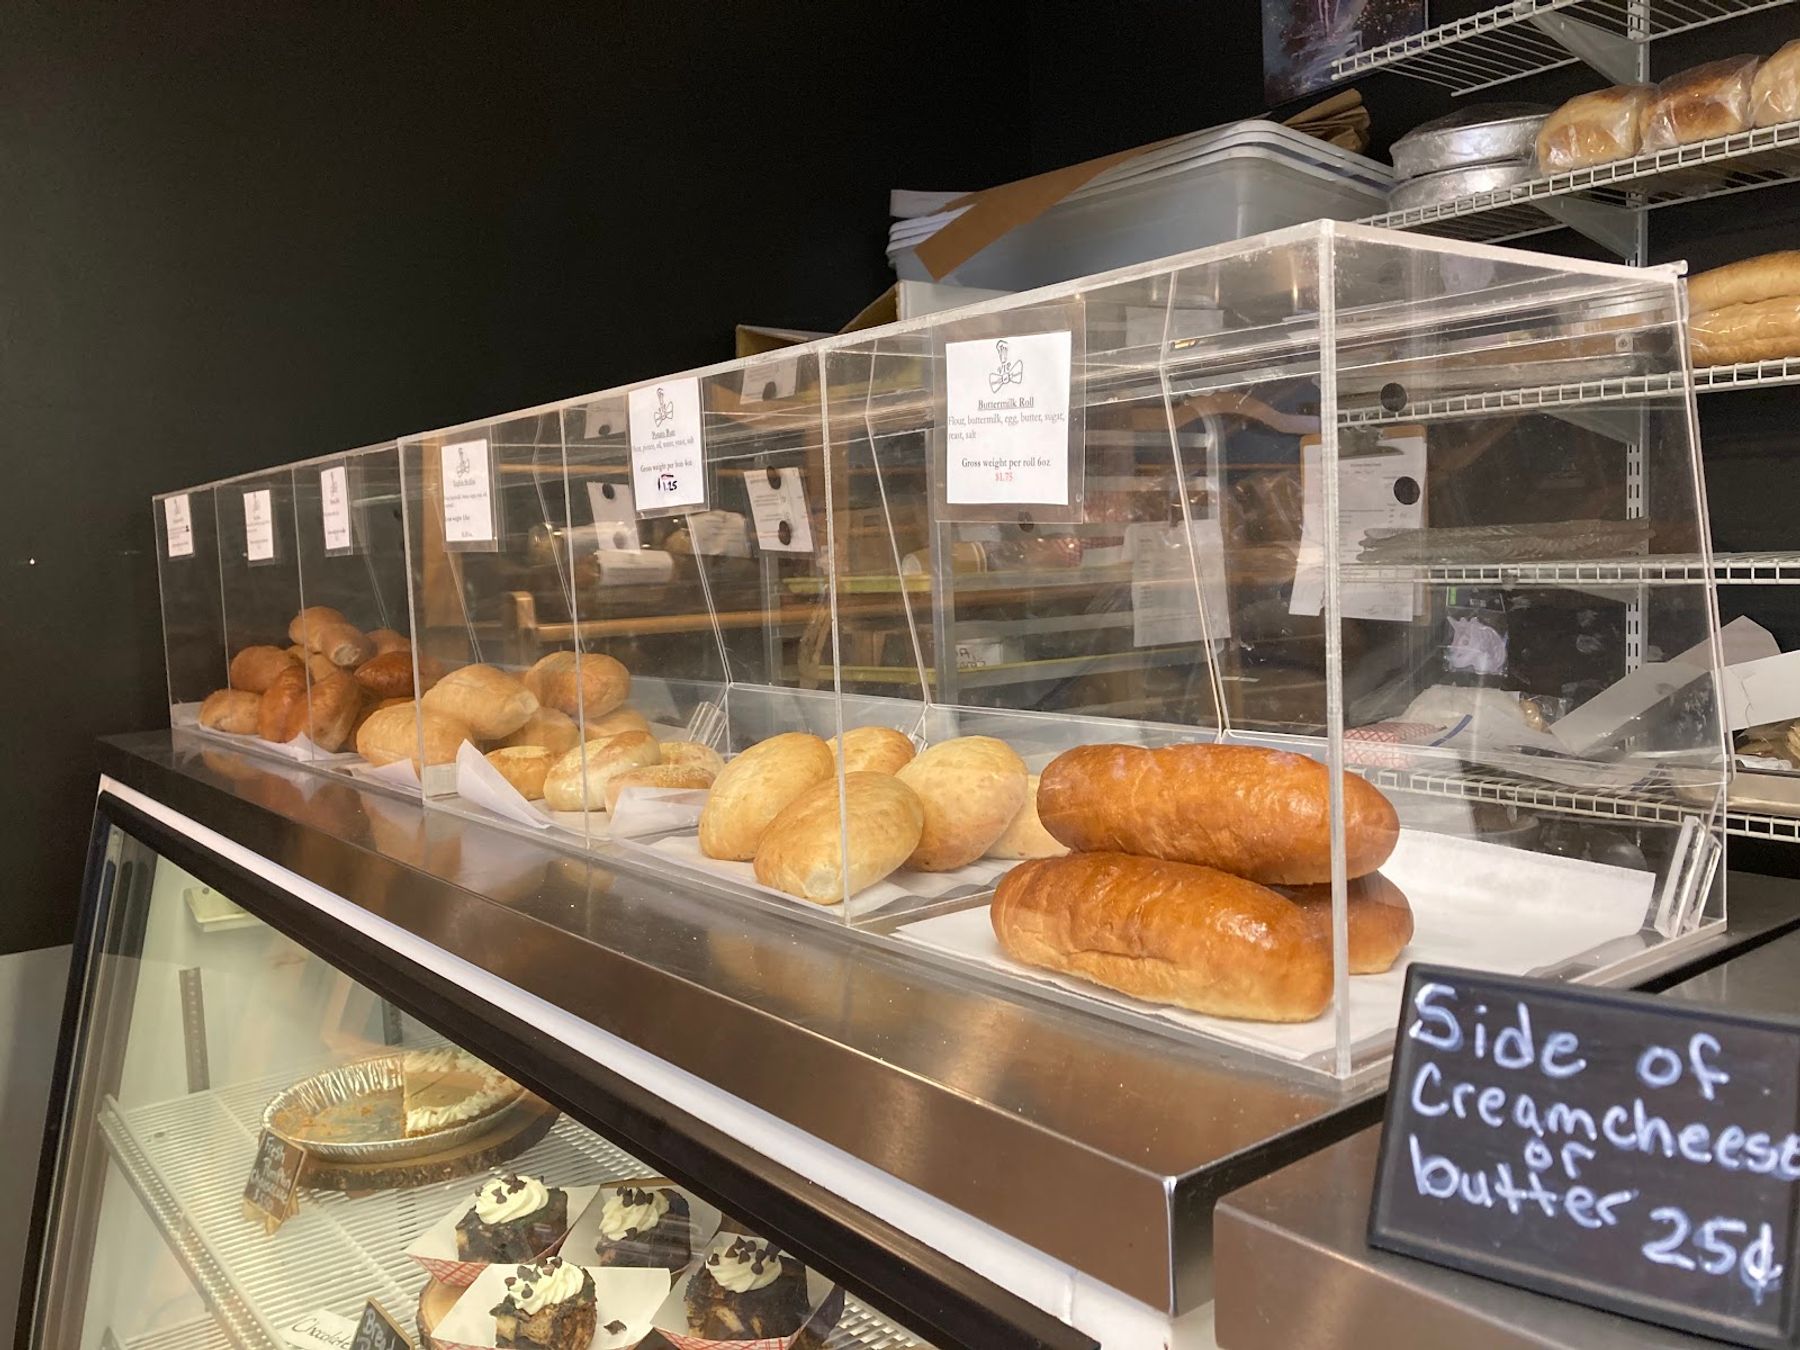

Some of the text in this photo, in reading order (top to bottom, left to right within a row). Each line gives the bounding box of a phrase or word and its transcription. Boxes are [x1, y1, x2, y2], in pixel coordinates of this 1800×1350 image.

[977, 397, 1035, 411] Buttermilk Roll
[1004, 415, 1020, 426] egg,
[961, 457, 982, 468] Gross
[982, 457, 1007, 469] weight
[1008, 460, 1021, 470] per
[1022, 457, 1035, 468] roll
[1409, 983, 1730, 1101] Side of
[1523, 1139, 1596, 1179] or
[1409, 1133, 1783, 1305] butter 25¢
